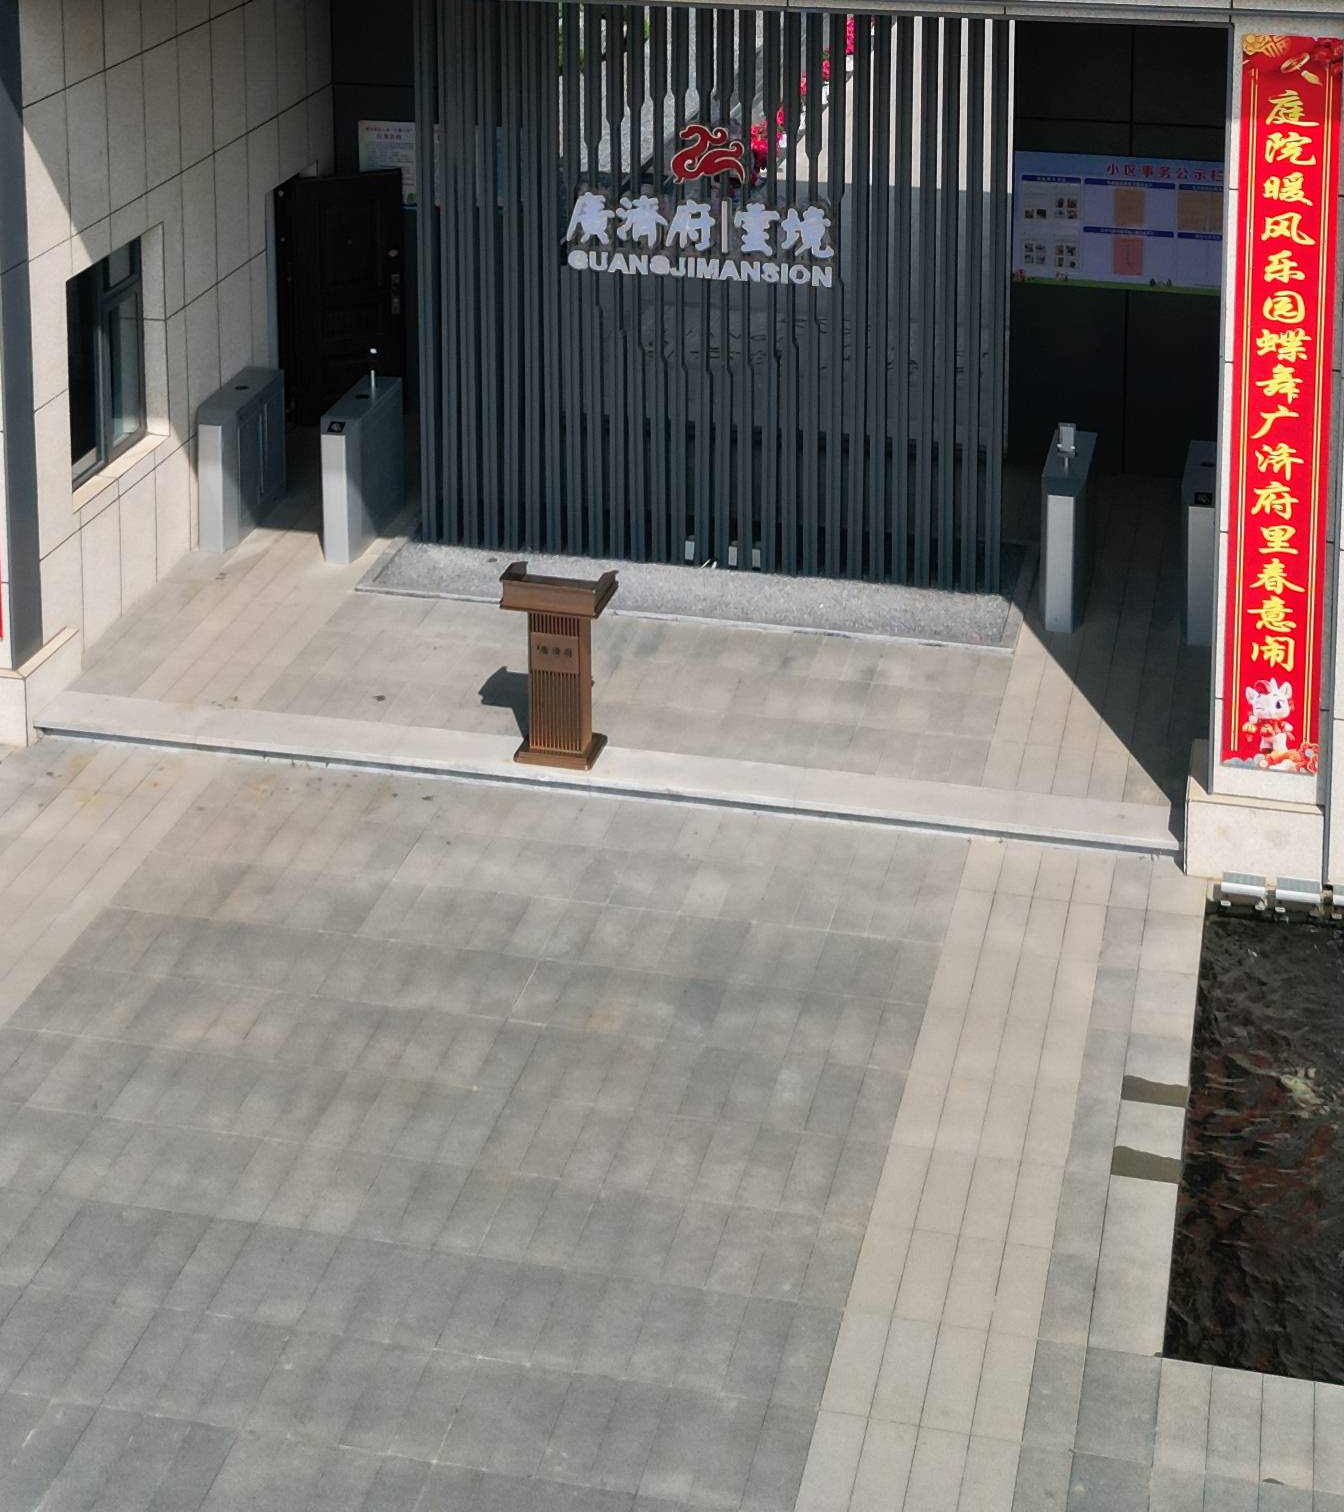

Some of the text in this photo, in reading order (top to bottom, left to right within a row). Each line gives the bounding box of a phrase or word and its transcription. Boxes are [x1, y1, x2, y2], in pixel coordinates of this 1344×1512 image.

[1247, 88, 1321, 674] 庭院暖风乐园蝶舞广济府里春意闹
